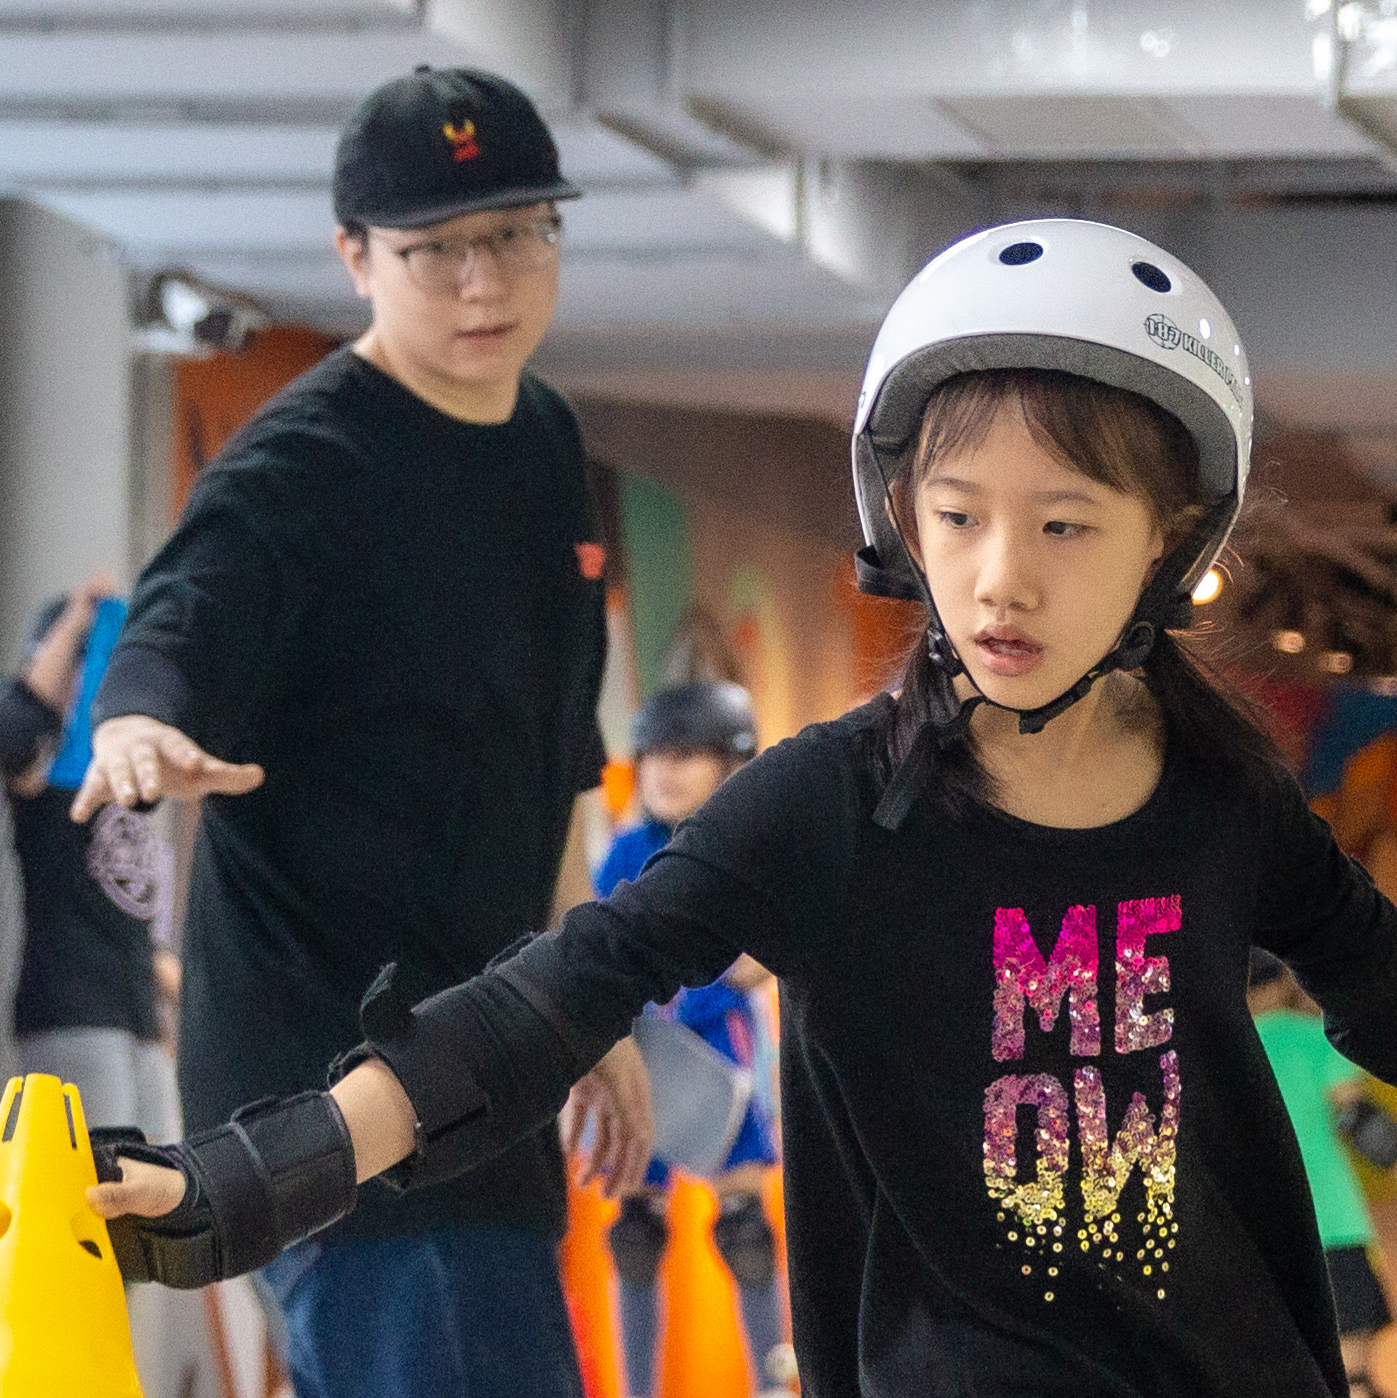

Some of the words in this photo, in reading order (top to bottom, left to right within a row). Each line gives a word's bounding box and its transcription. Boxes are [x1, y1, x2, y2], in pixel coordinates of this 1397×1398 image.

[1145, 317, 1182, 347] 187
[1182, 332, 1225, 382] KILLER
[991, 893, 1182, 1062] ME
[982, 1050, 1182, 1218] OW
